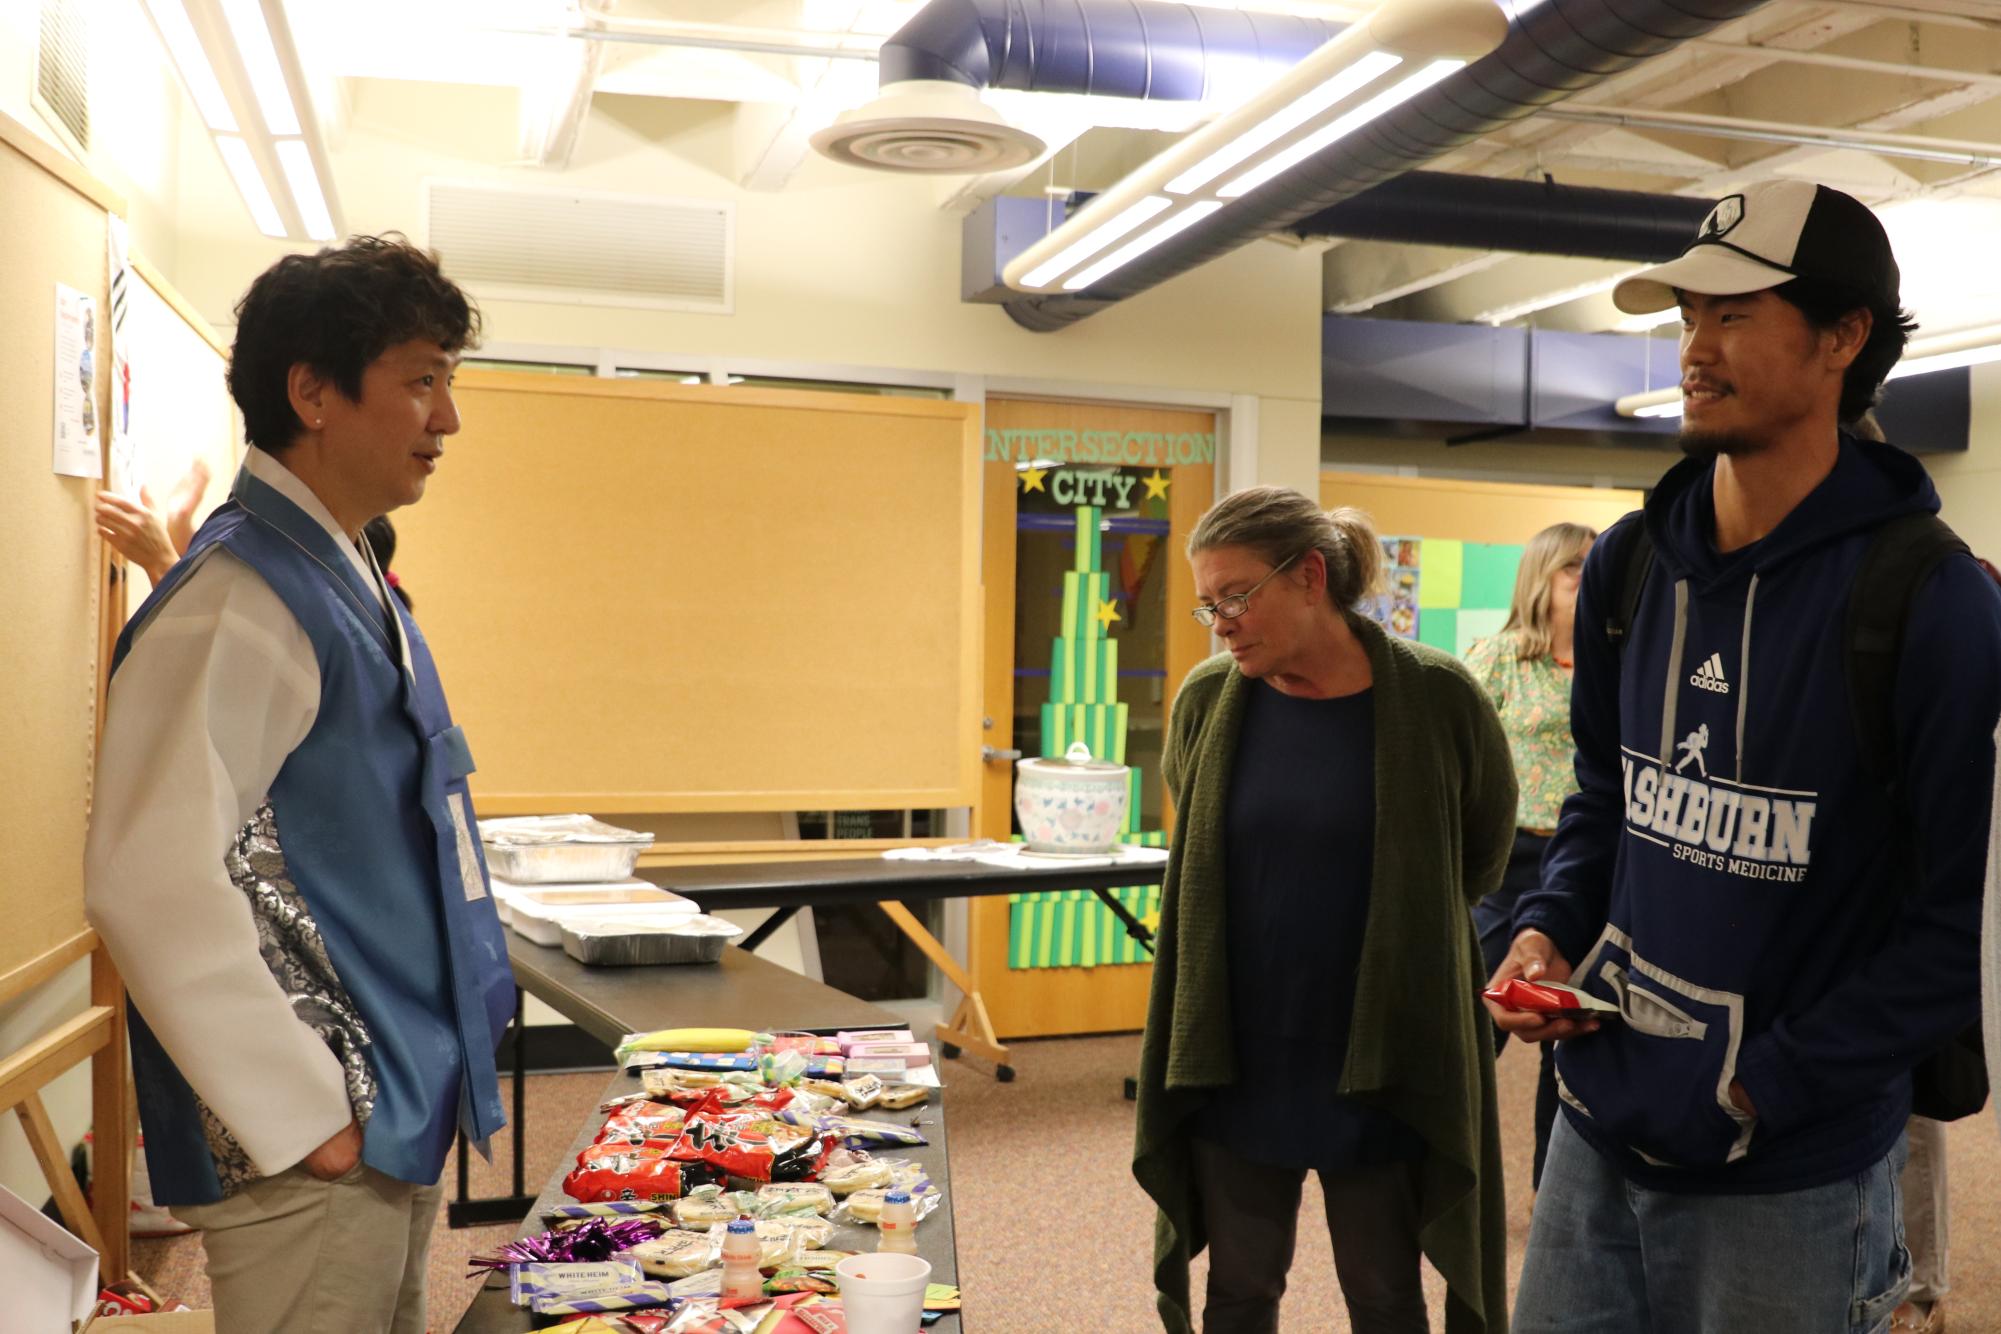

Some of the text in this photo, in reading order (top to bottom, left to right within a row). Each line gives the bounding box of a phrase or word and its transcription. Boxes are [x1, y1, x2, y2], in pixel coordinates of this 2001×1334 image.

[1052, 470, 1137, 509] CITY
[1690, 674, 1729, 694] adidas
[837, 815, 870, 827] TRANS
[1672, 843, 1808, 882] SPORTS MEDICINE
